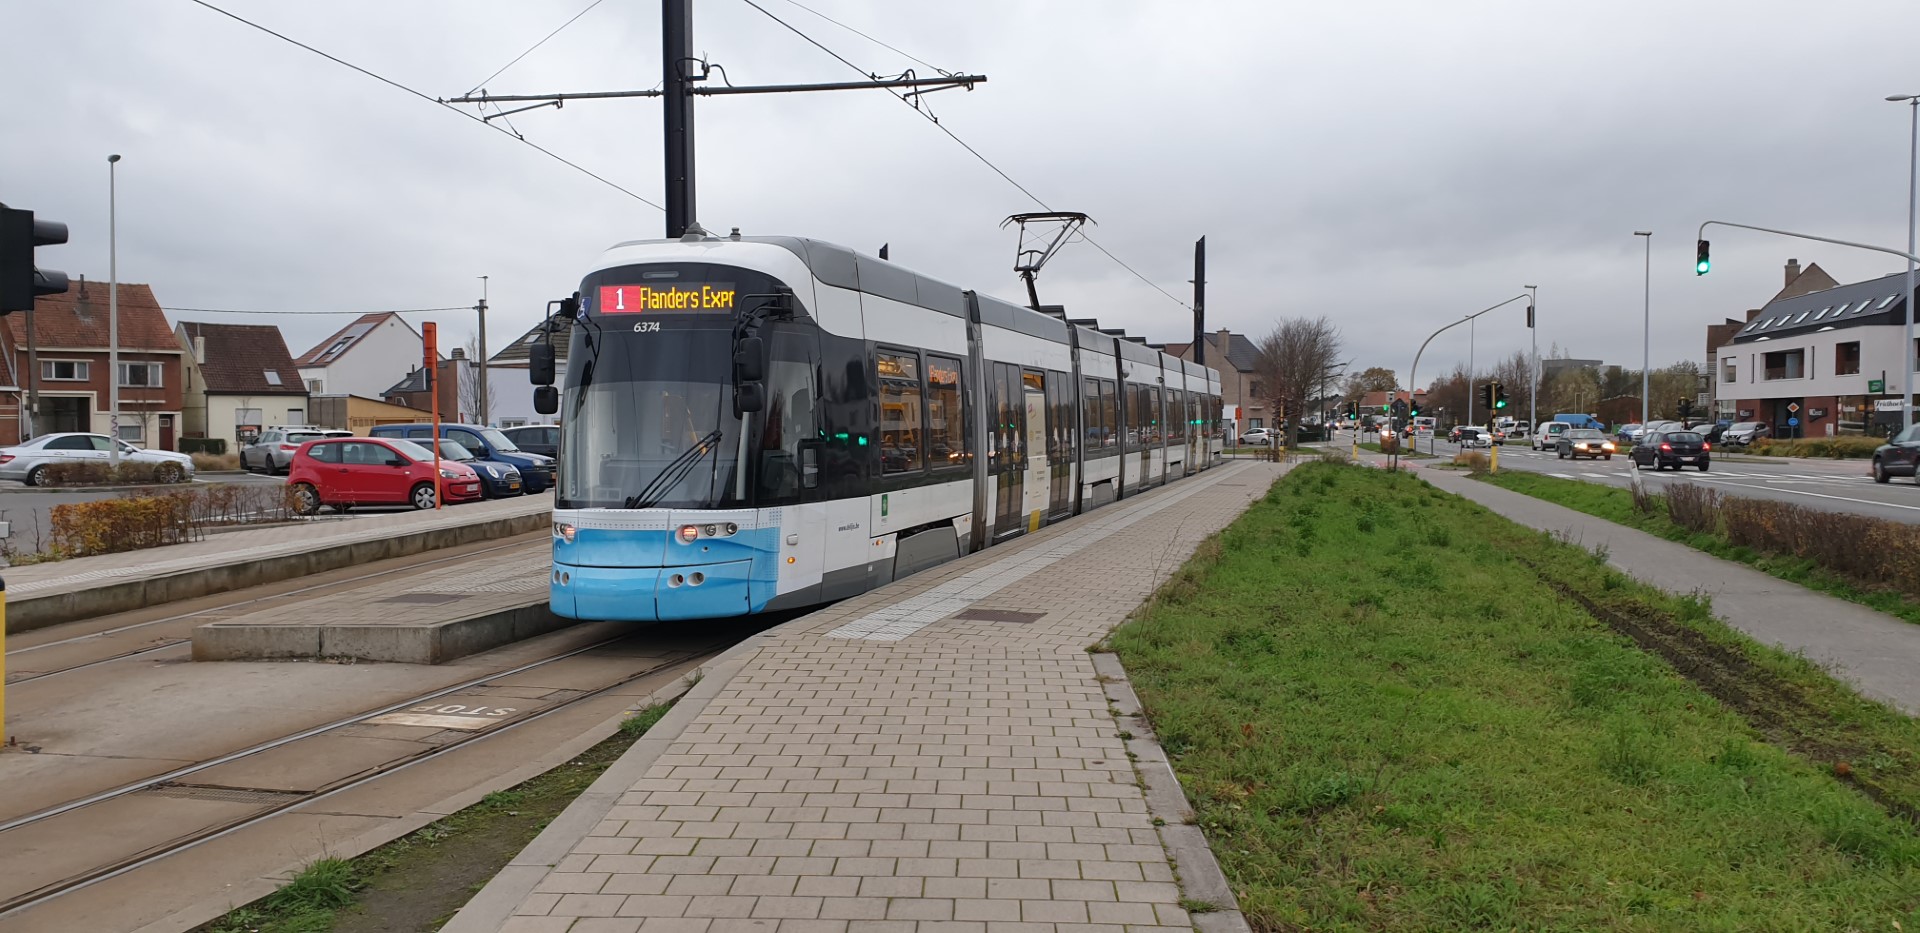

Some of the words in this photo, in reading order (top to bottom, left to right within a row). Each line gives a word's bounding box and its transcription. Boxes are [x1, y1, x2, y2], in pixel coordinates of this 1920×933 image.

[616, 288, 625, 310] 1
[640, 287, 699, 310] Flanders
[633, 322, 661, 332] 6374
[409, 703, 517, 717] STOP
